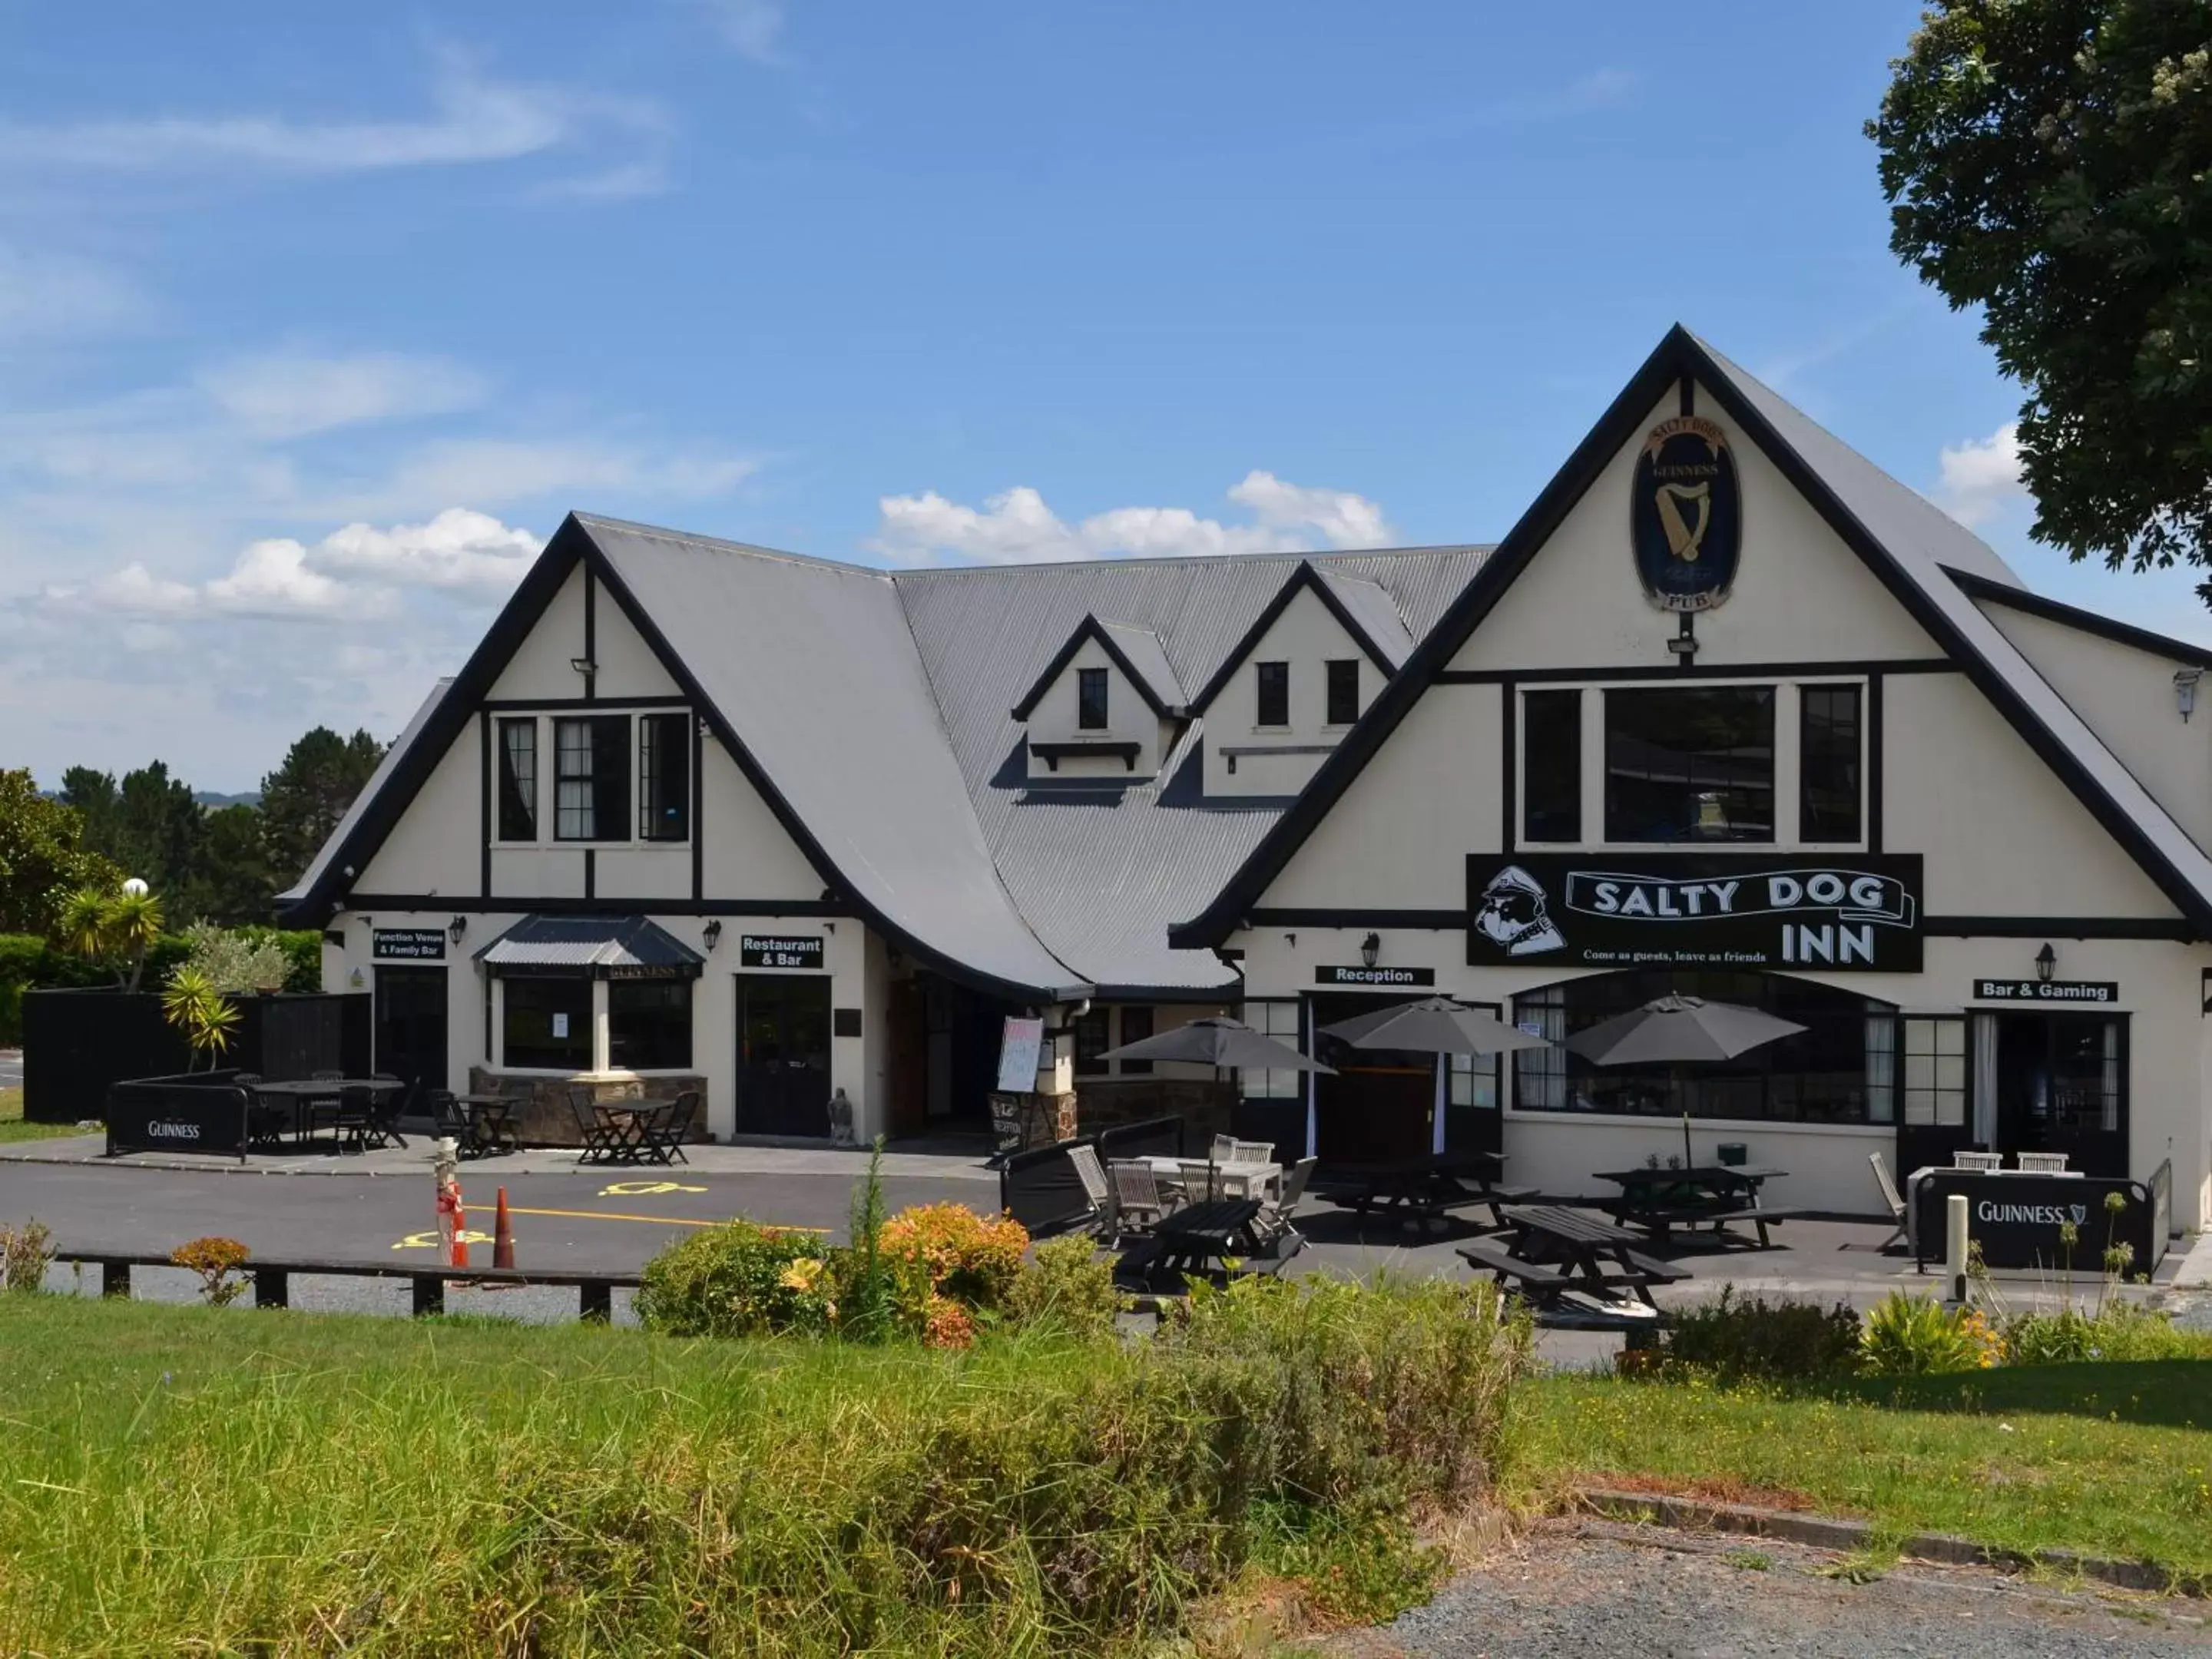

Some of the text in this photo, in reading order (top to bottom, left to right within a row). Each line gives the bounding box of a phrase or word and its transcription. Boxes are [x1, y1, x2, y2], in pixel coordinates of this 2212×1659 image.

[1653, 463, 1718, 477] GUINNESS
[1668, 593, 1710, 609] PUB
[1594, 873, 1885, 916] SALTY DOG
[374, 932, 443, 942] Function Venue
[743, 937, 821, 952] Restaurant
[1782, 924, 1874, 964] INN
[380, 945, 438, 955] & Family Bar
[1583, 949, 1616, 960] Come
[1618, 952, 1631, 960] as
[1633, 951, 1672, 962] guests,
[1674, 951, 1706, 962] leave
[1724, 952, 1767, 963] friends
[762, 952, 803, 965] & Bar
[1336, 968, 1414, 983] Reception
[1982, 982, 2108, 1001] Bar & Gaming
[148, 1121, 200, 1137] GUINNESS
[1978, 1200, 2065, 1224] GUINNESS
